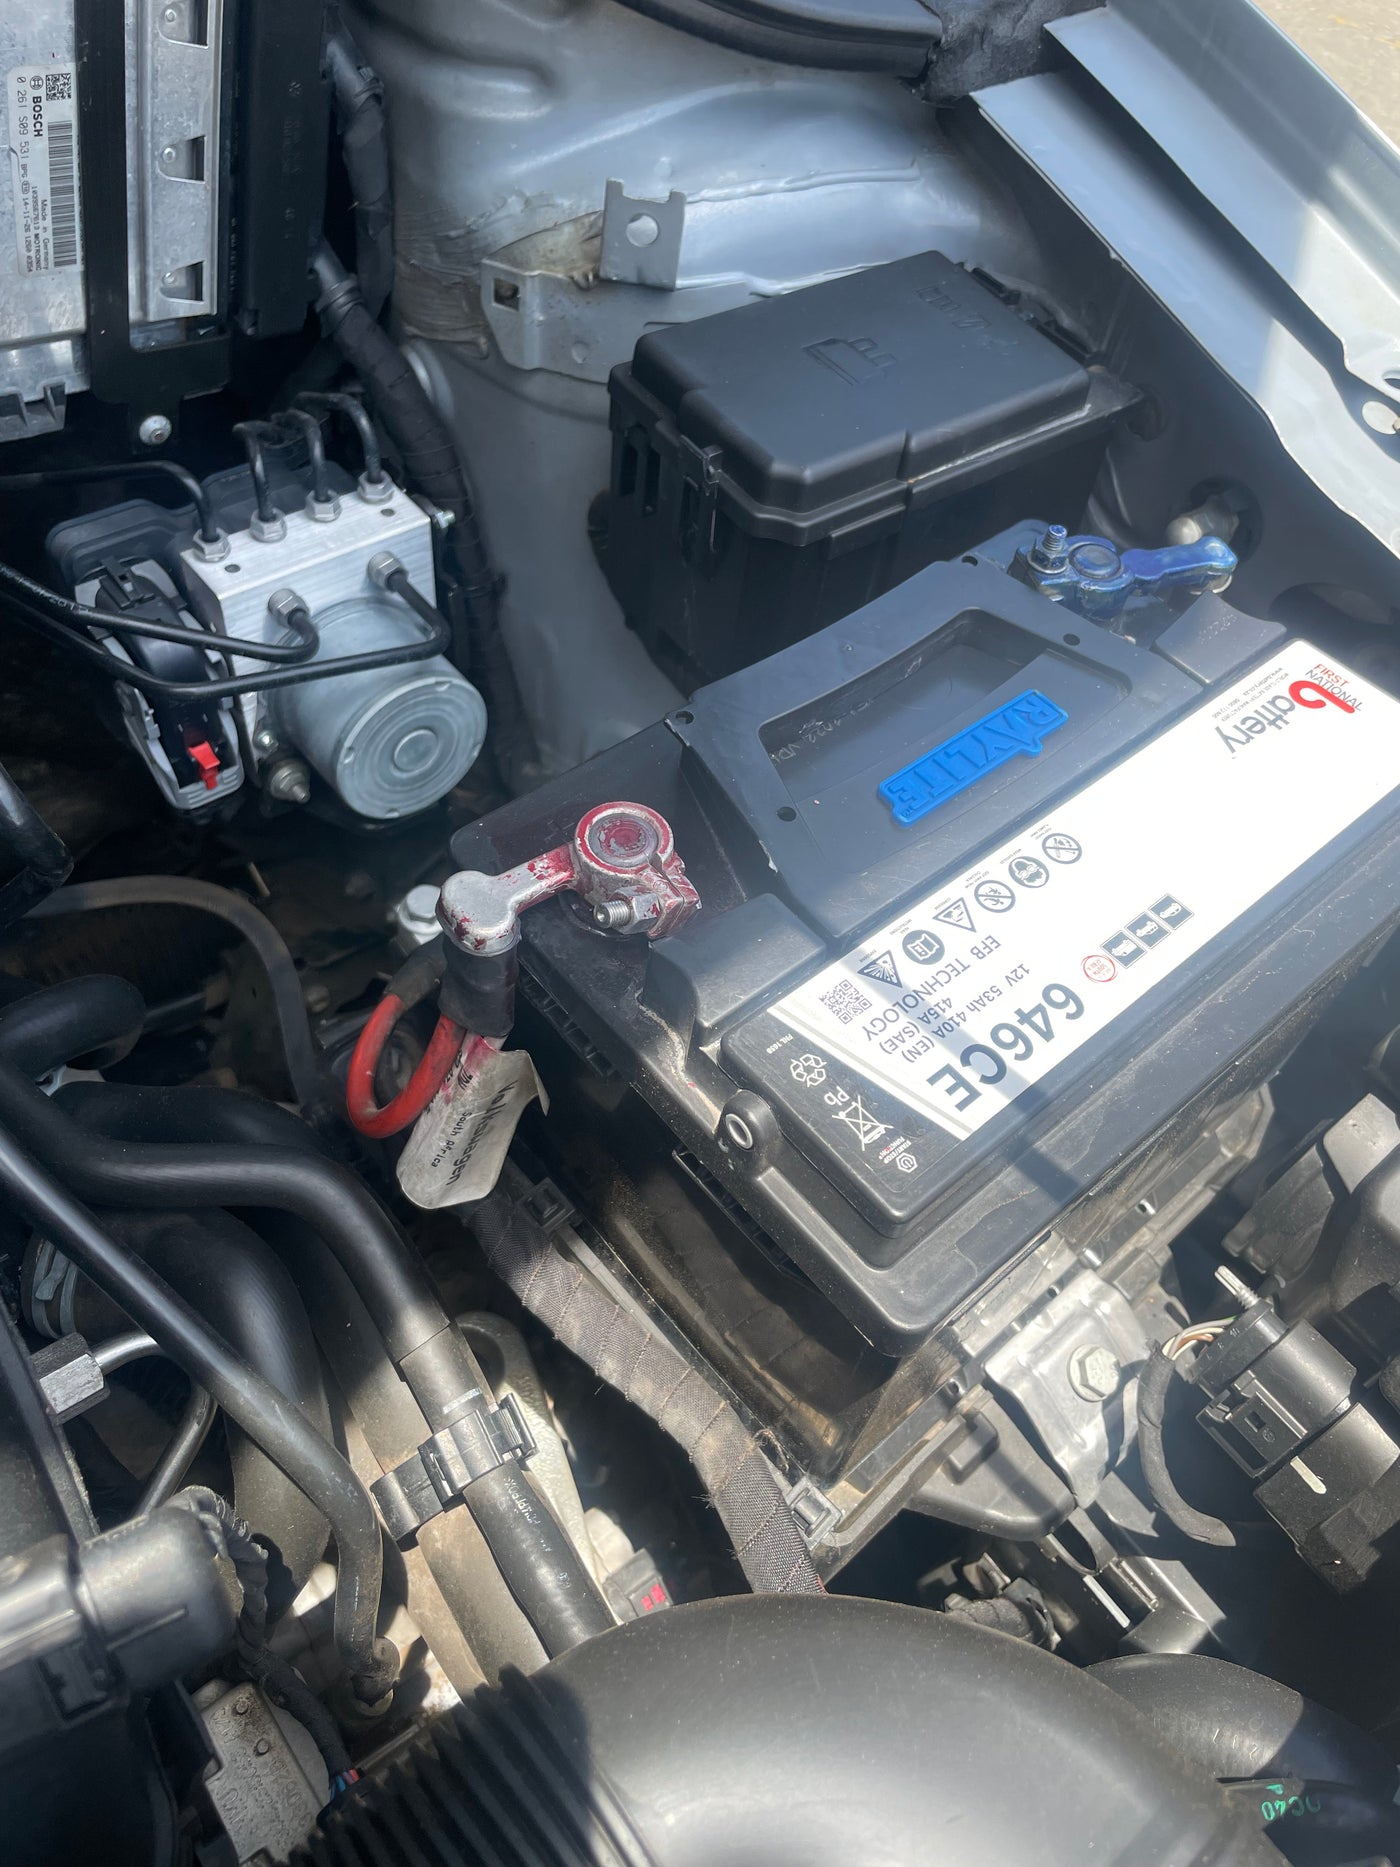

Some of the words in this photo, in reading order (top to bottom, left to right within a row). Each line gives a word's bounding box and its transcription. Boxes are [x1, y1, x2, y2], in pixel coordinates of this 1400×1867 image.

[17, 90, 28, 108] 261
[32, 96, 43, 137] BOSCH
[20, 141, 29, 159] 531
[1313, 664, 1350, 687] FIRST
[1305, 670, 1364, 711] NATIONAL
[1215, 680, 1356, 754] battery
[887, 693, 1061, 810] RAYLITE
[970, 935, 1002, 960] EFB
[1004, 963, 1030, 987] 12V
[862, 958, 971, 1041] TECHNOLOGY
[918, 998, 953, 1025] 415A
[966, 985, 1003, 1012] 53Ah
[879, 1021, 920, 1054] (SAE)
[932, 1011, 967, 1039] 410A
[901, 1035, 935, 1064] (EN)
[926, 983, 1085, 1112] 646CE
[824, 1086, 850, 1106] Pb
[446, 1080, 518, 1186] Volkswagen
[451, 1112, 472, 1136] South
[884, 1140, 912, 1164] START/STOP
